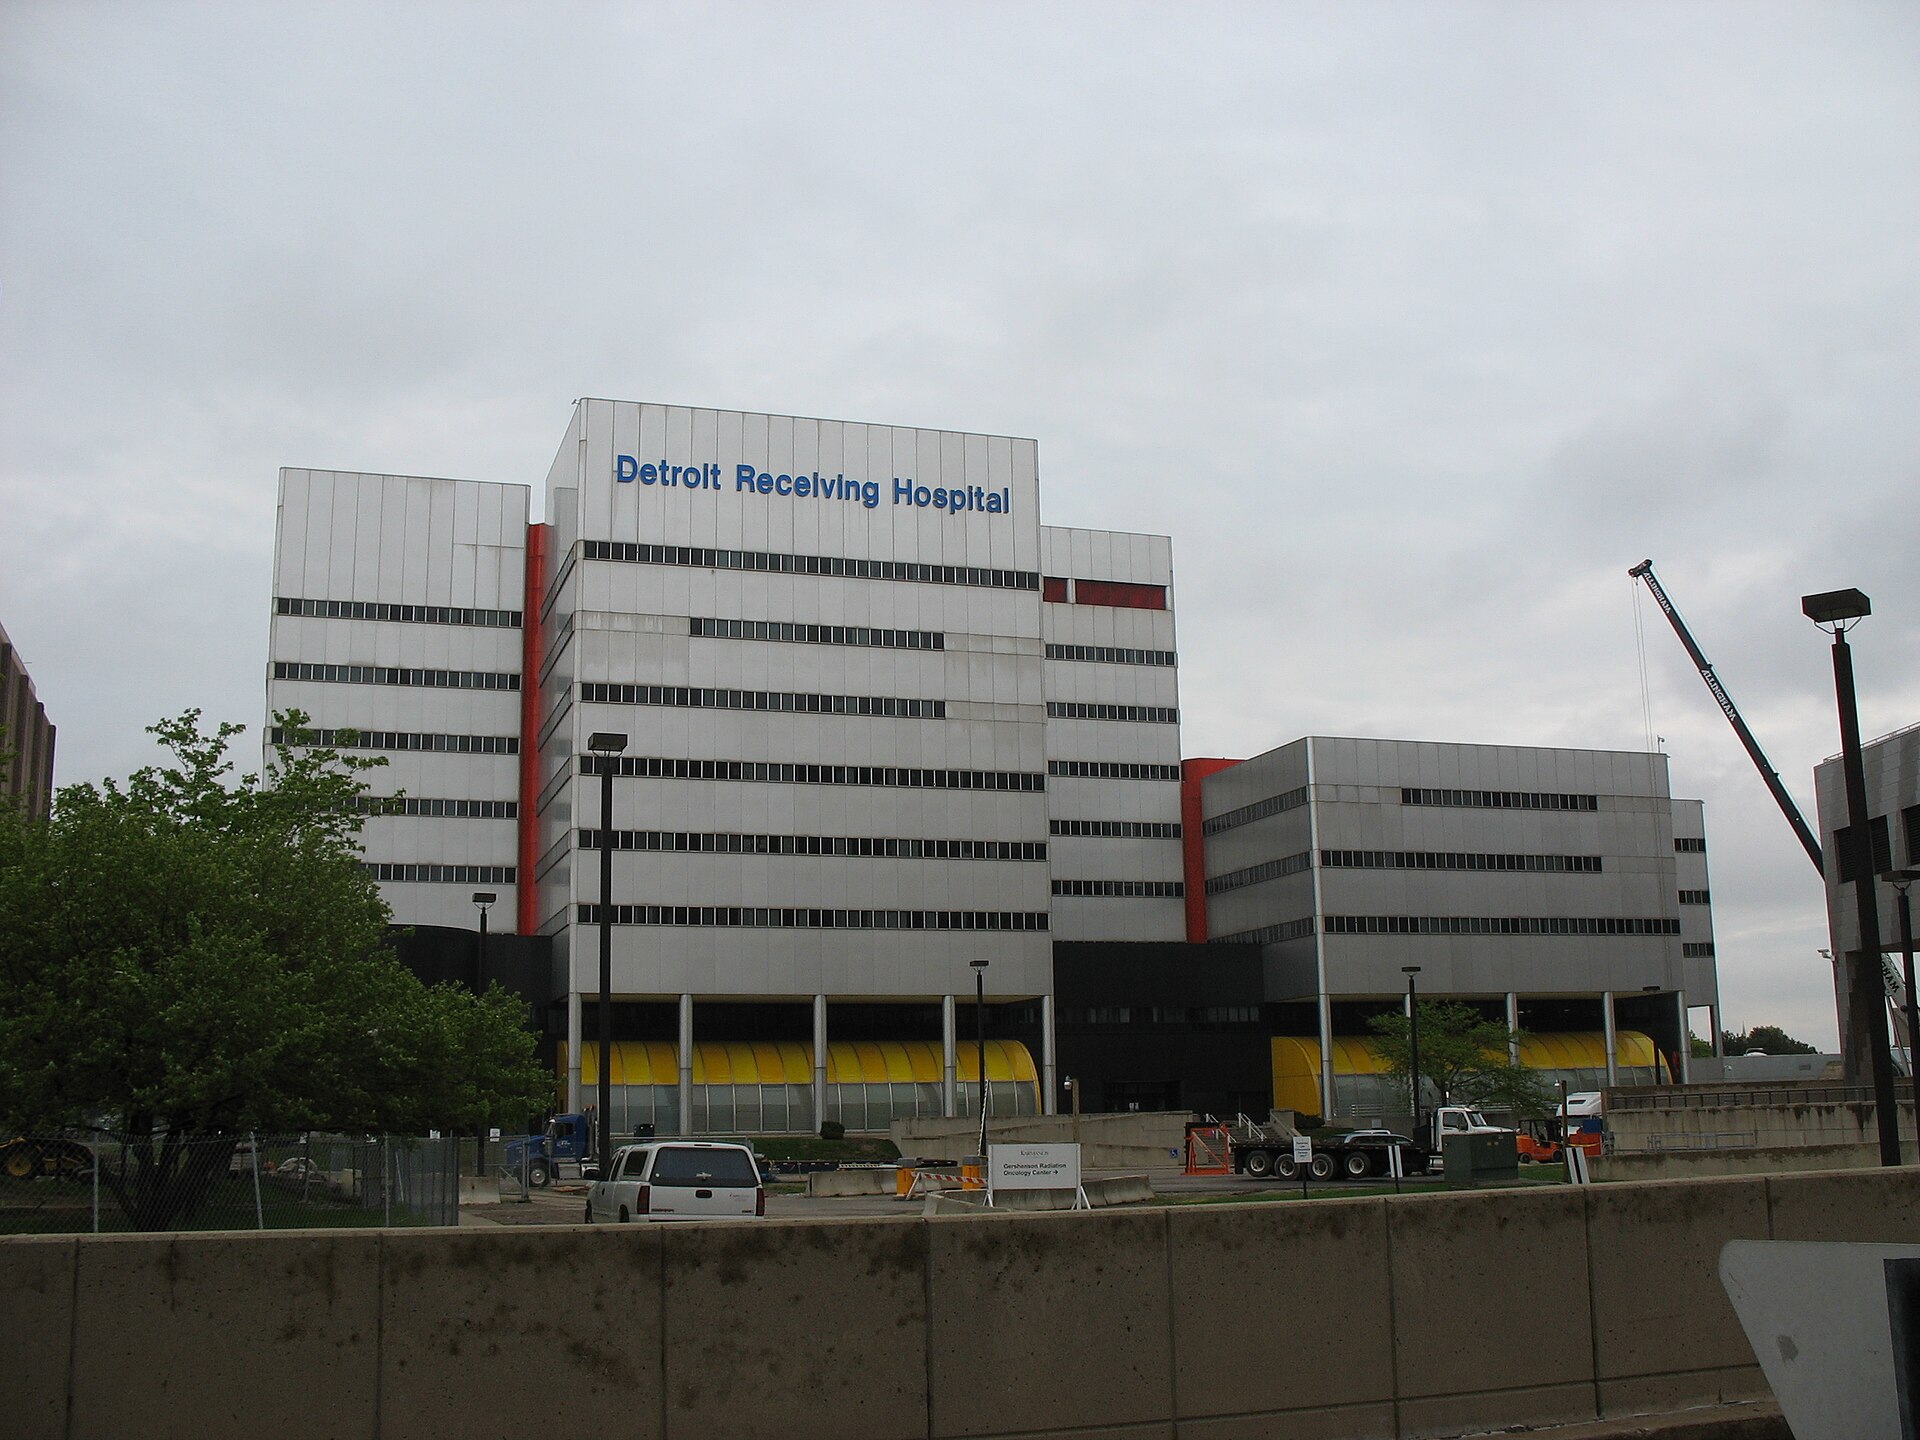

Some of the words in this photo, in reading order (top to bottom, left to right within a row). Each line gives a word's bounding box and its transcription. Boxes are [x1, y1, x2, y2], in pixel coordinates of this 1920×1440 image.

[617, 454, 721, 490] Detroit
[736, 464, 879, 508] Receiving
[894, 478, 1009, 515] Hospital
[1643, 572, 1671, 614] ALLINGHAM
[1701, 669, 1736, 721] ALLINGHAM
